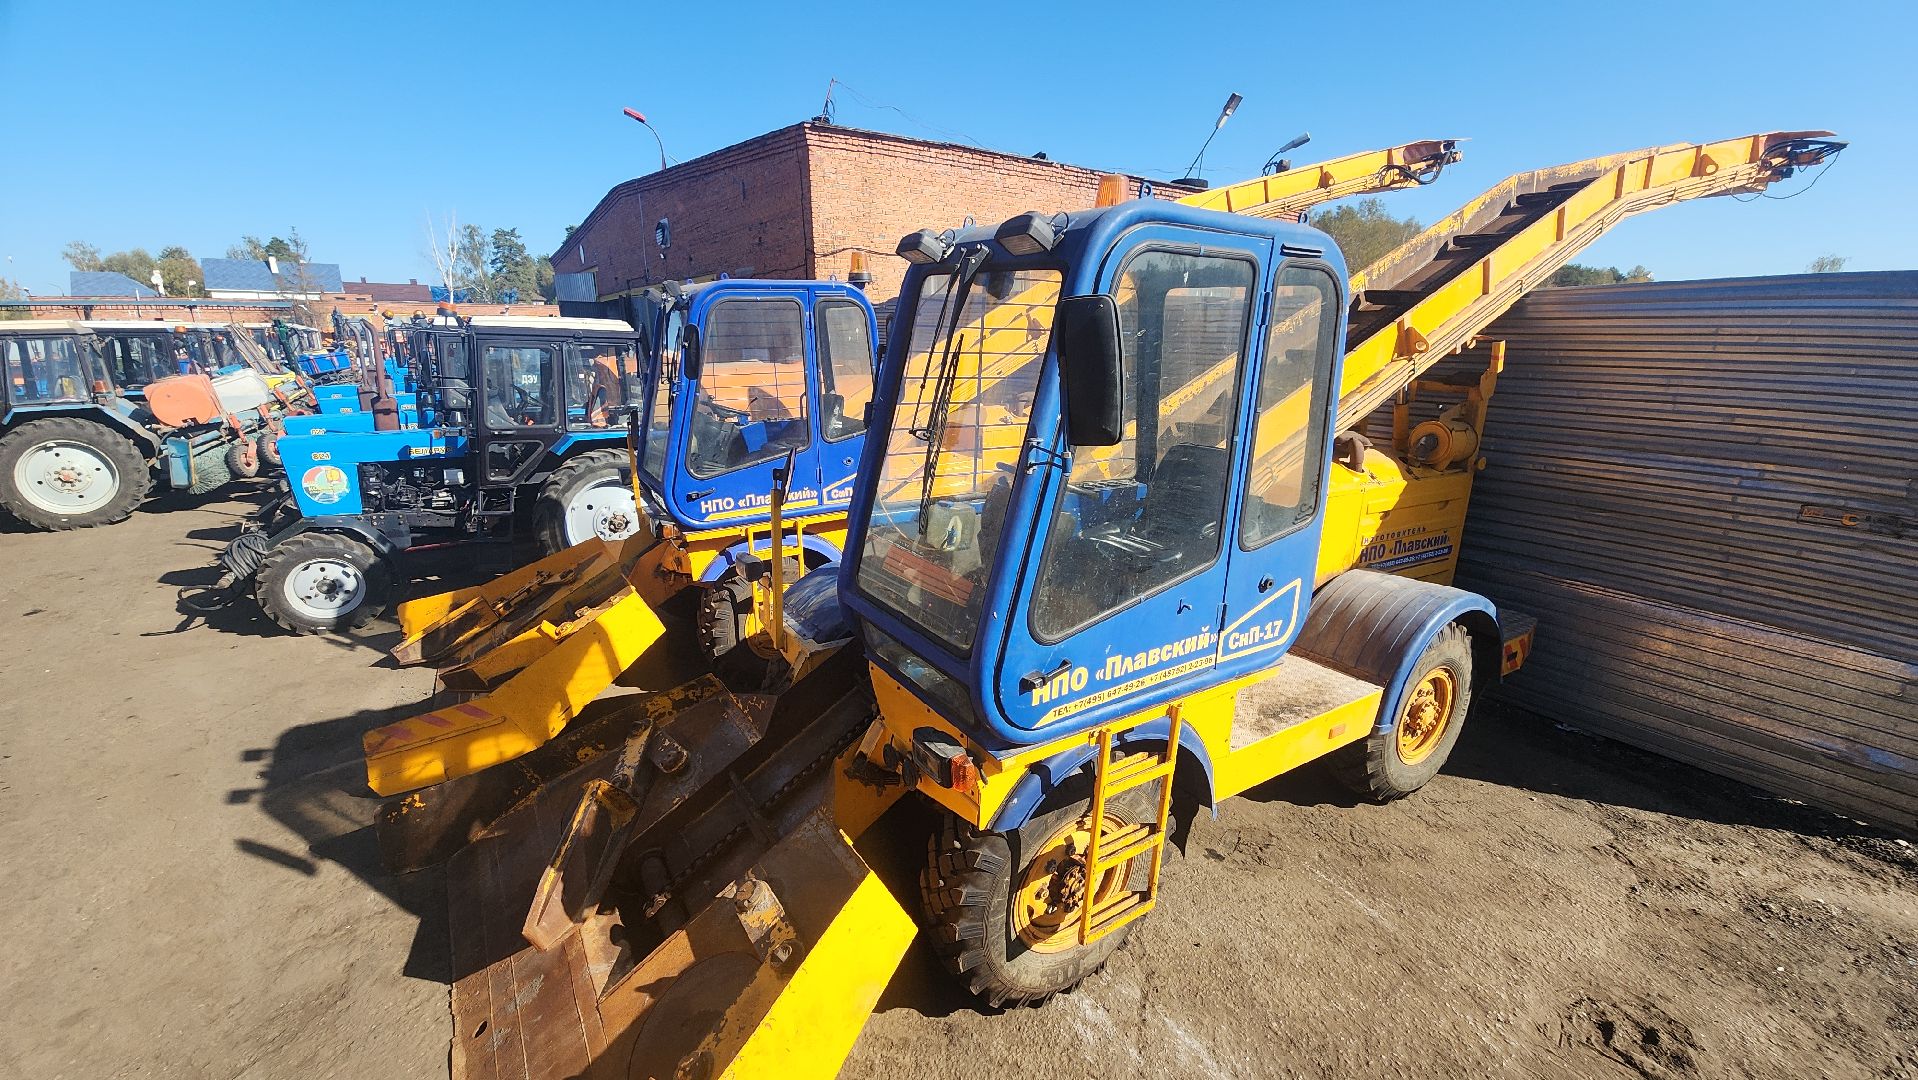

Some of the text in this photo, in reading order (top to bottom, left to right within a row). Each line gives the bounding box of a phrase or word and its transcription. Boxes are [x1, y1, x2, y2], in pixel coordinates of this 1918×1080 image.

[521, 374, 538, 385] ДЭУ
[701, 487, 818, 514] НПО «Плакий»
[1359, 545, 1386, 563] НПО
[1228, 619, 1284, 650] СнП-17
[1095, 625, 1218, 681] «Плавский»
